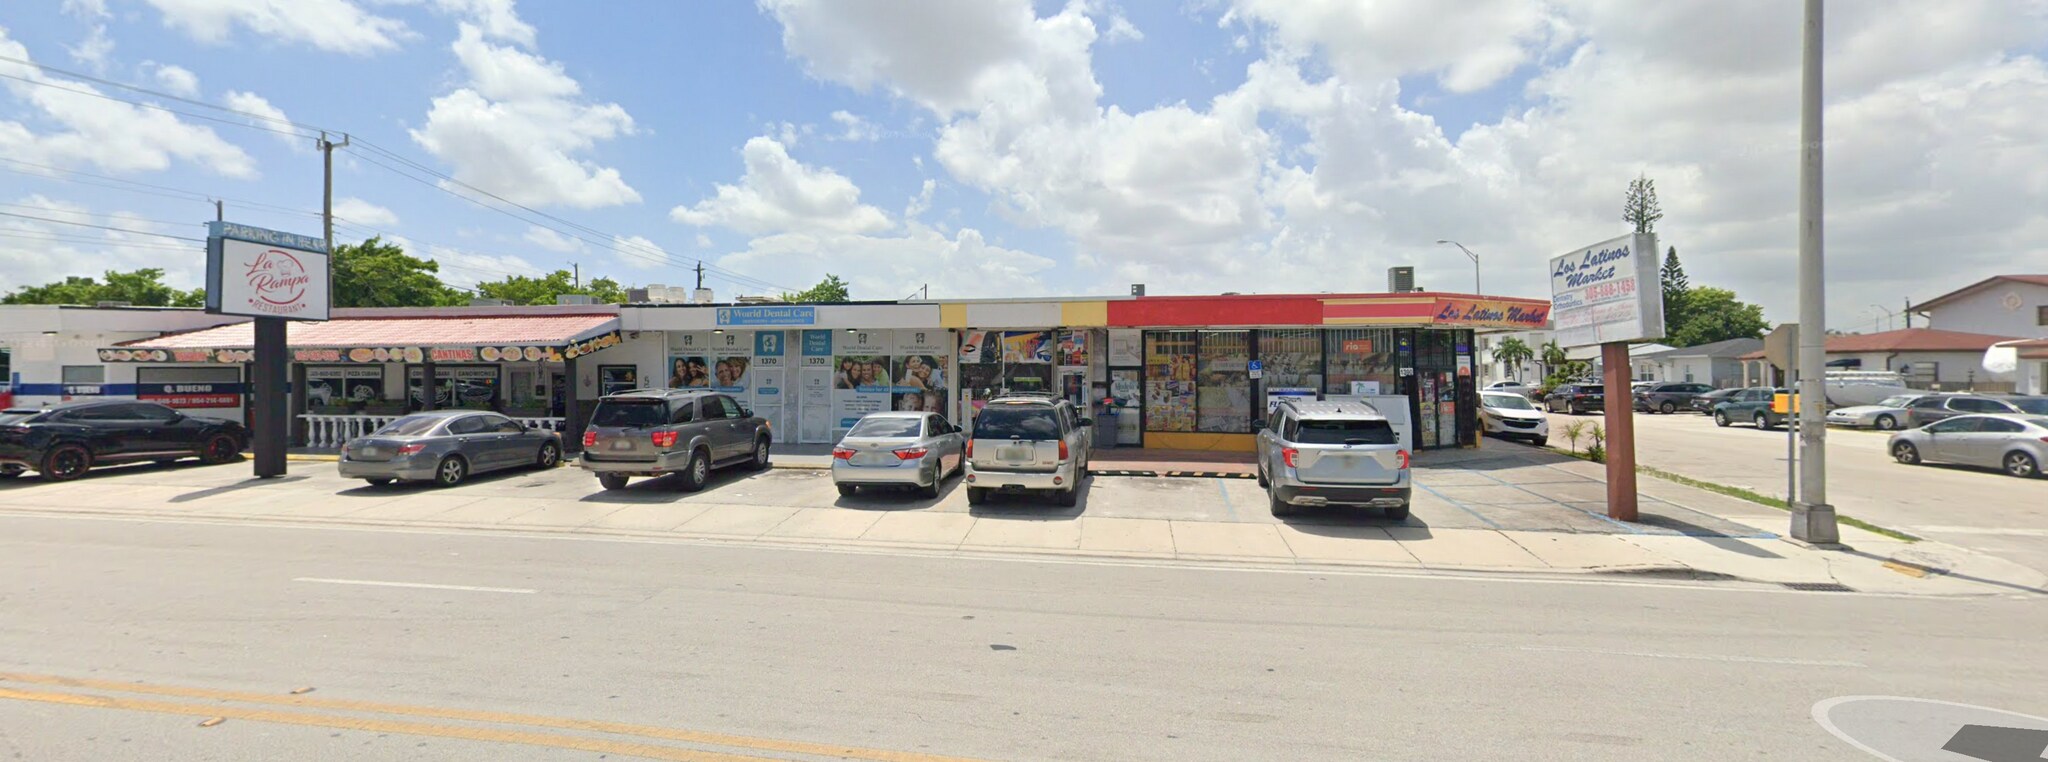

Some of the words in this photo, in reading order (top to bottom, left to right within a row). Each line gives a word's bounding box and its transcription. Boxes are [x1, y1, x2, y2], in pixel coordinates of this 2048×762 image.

[223, 223, 279, 242] PARKING
[282, 234, 294, 244] IN
[244, 252, 273, 277] La
[1553, 258, 1576, 278] Los
[1579, 245, 1630, 270] Latinos
[249, 273, 309, 294] Rampa
[1566, 265, 1616, 288] Market
[252, 300, 302, 314] RESTAURANT
[764, 308, 791, 317] Dental
[793, 308, 814, 317] Care
[1437, 303, 1459, 320] Los
[1462, 304, 1504, 322] Latinos
[1506, 306, 1546, 323] Market
[431, 349, 474, 360] CANTINAS
[176, 384, 212, 393] BUENO
